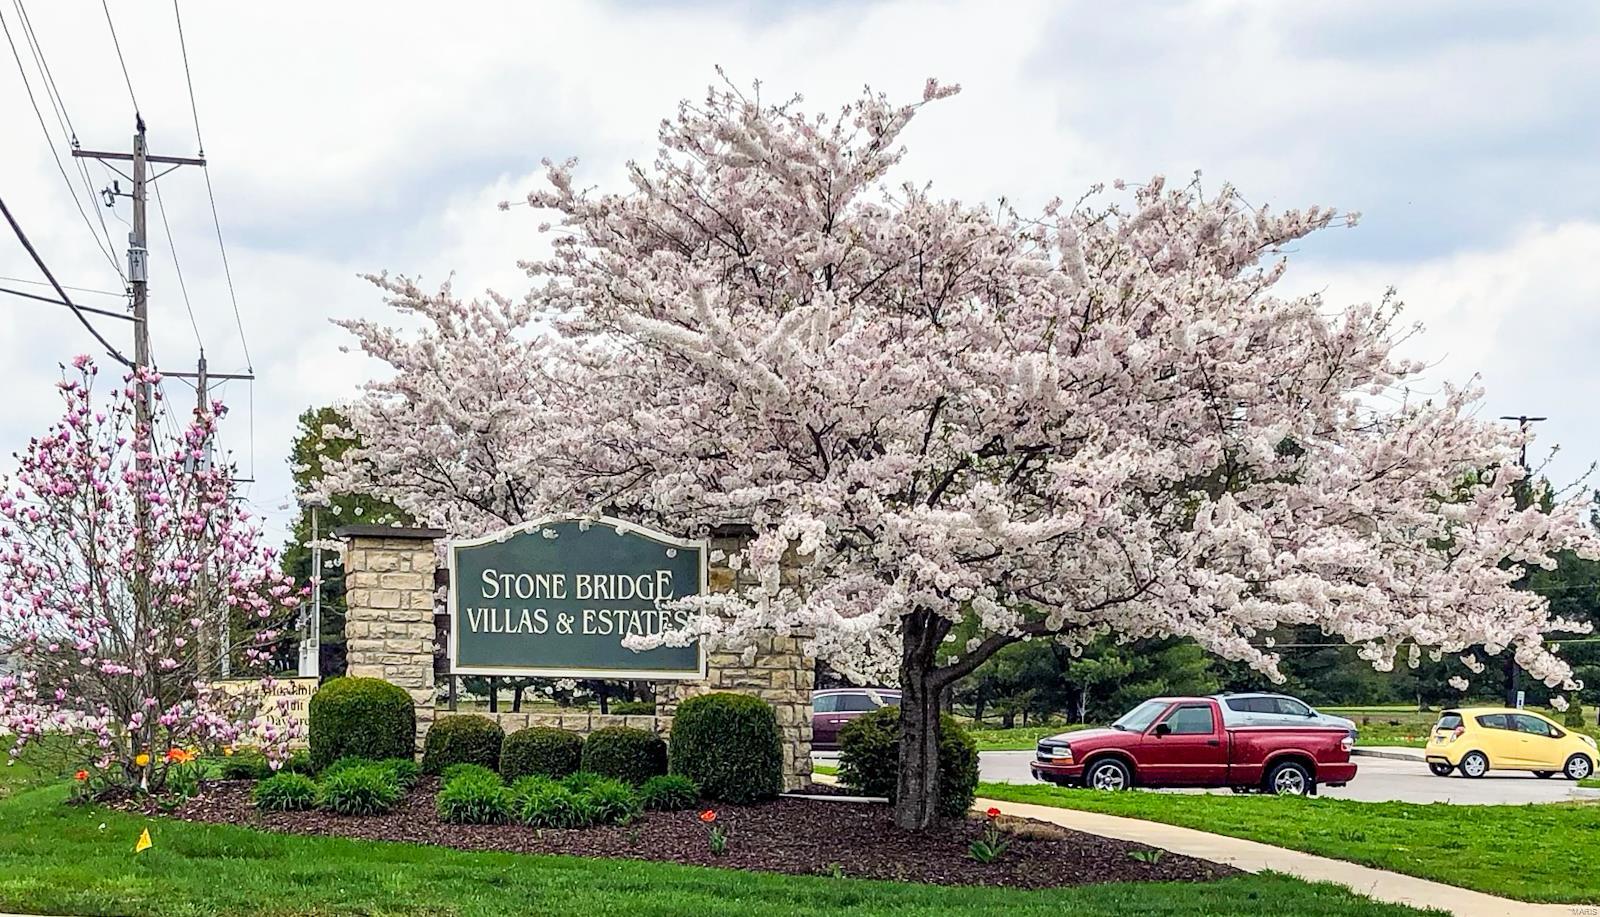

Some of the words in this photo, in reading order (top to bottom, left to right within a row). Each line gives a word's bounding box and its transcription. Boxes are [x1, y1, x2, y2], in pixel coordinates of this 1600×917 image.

[481, 568, 567, 599] STONE
[576, 569, 674, 600] BRIDGE
[466, 608, 549, 634] VILLAS
[556, 612, 575, 635] &
[582, 609, 688, 635] ESTATES
